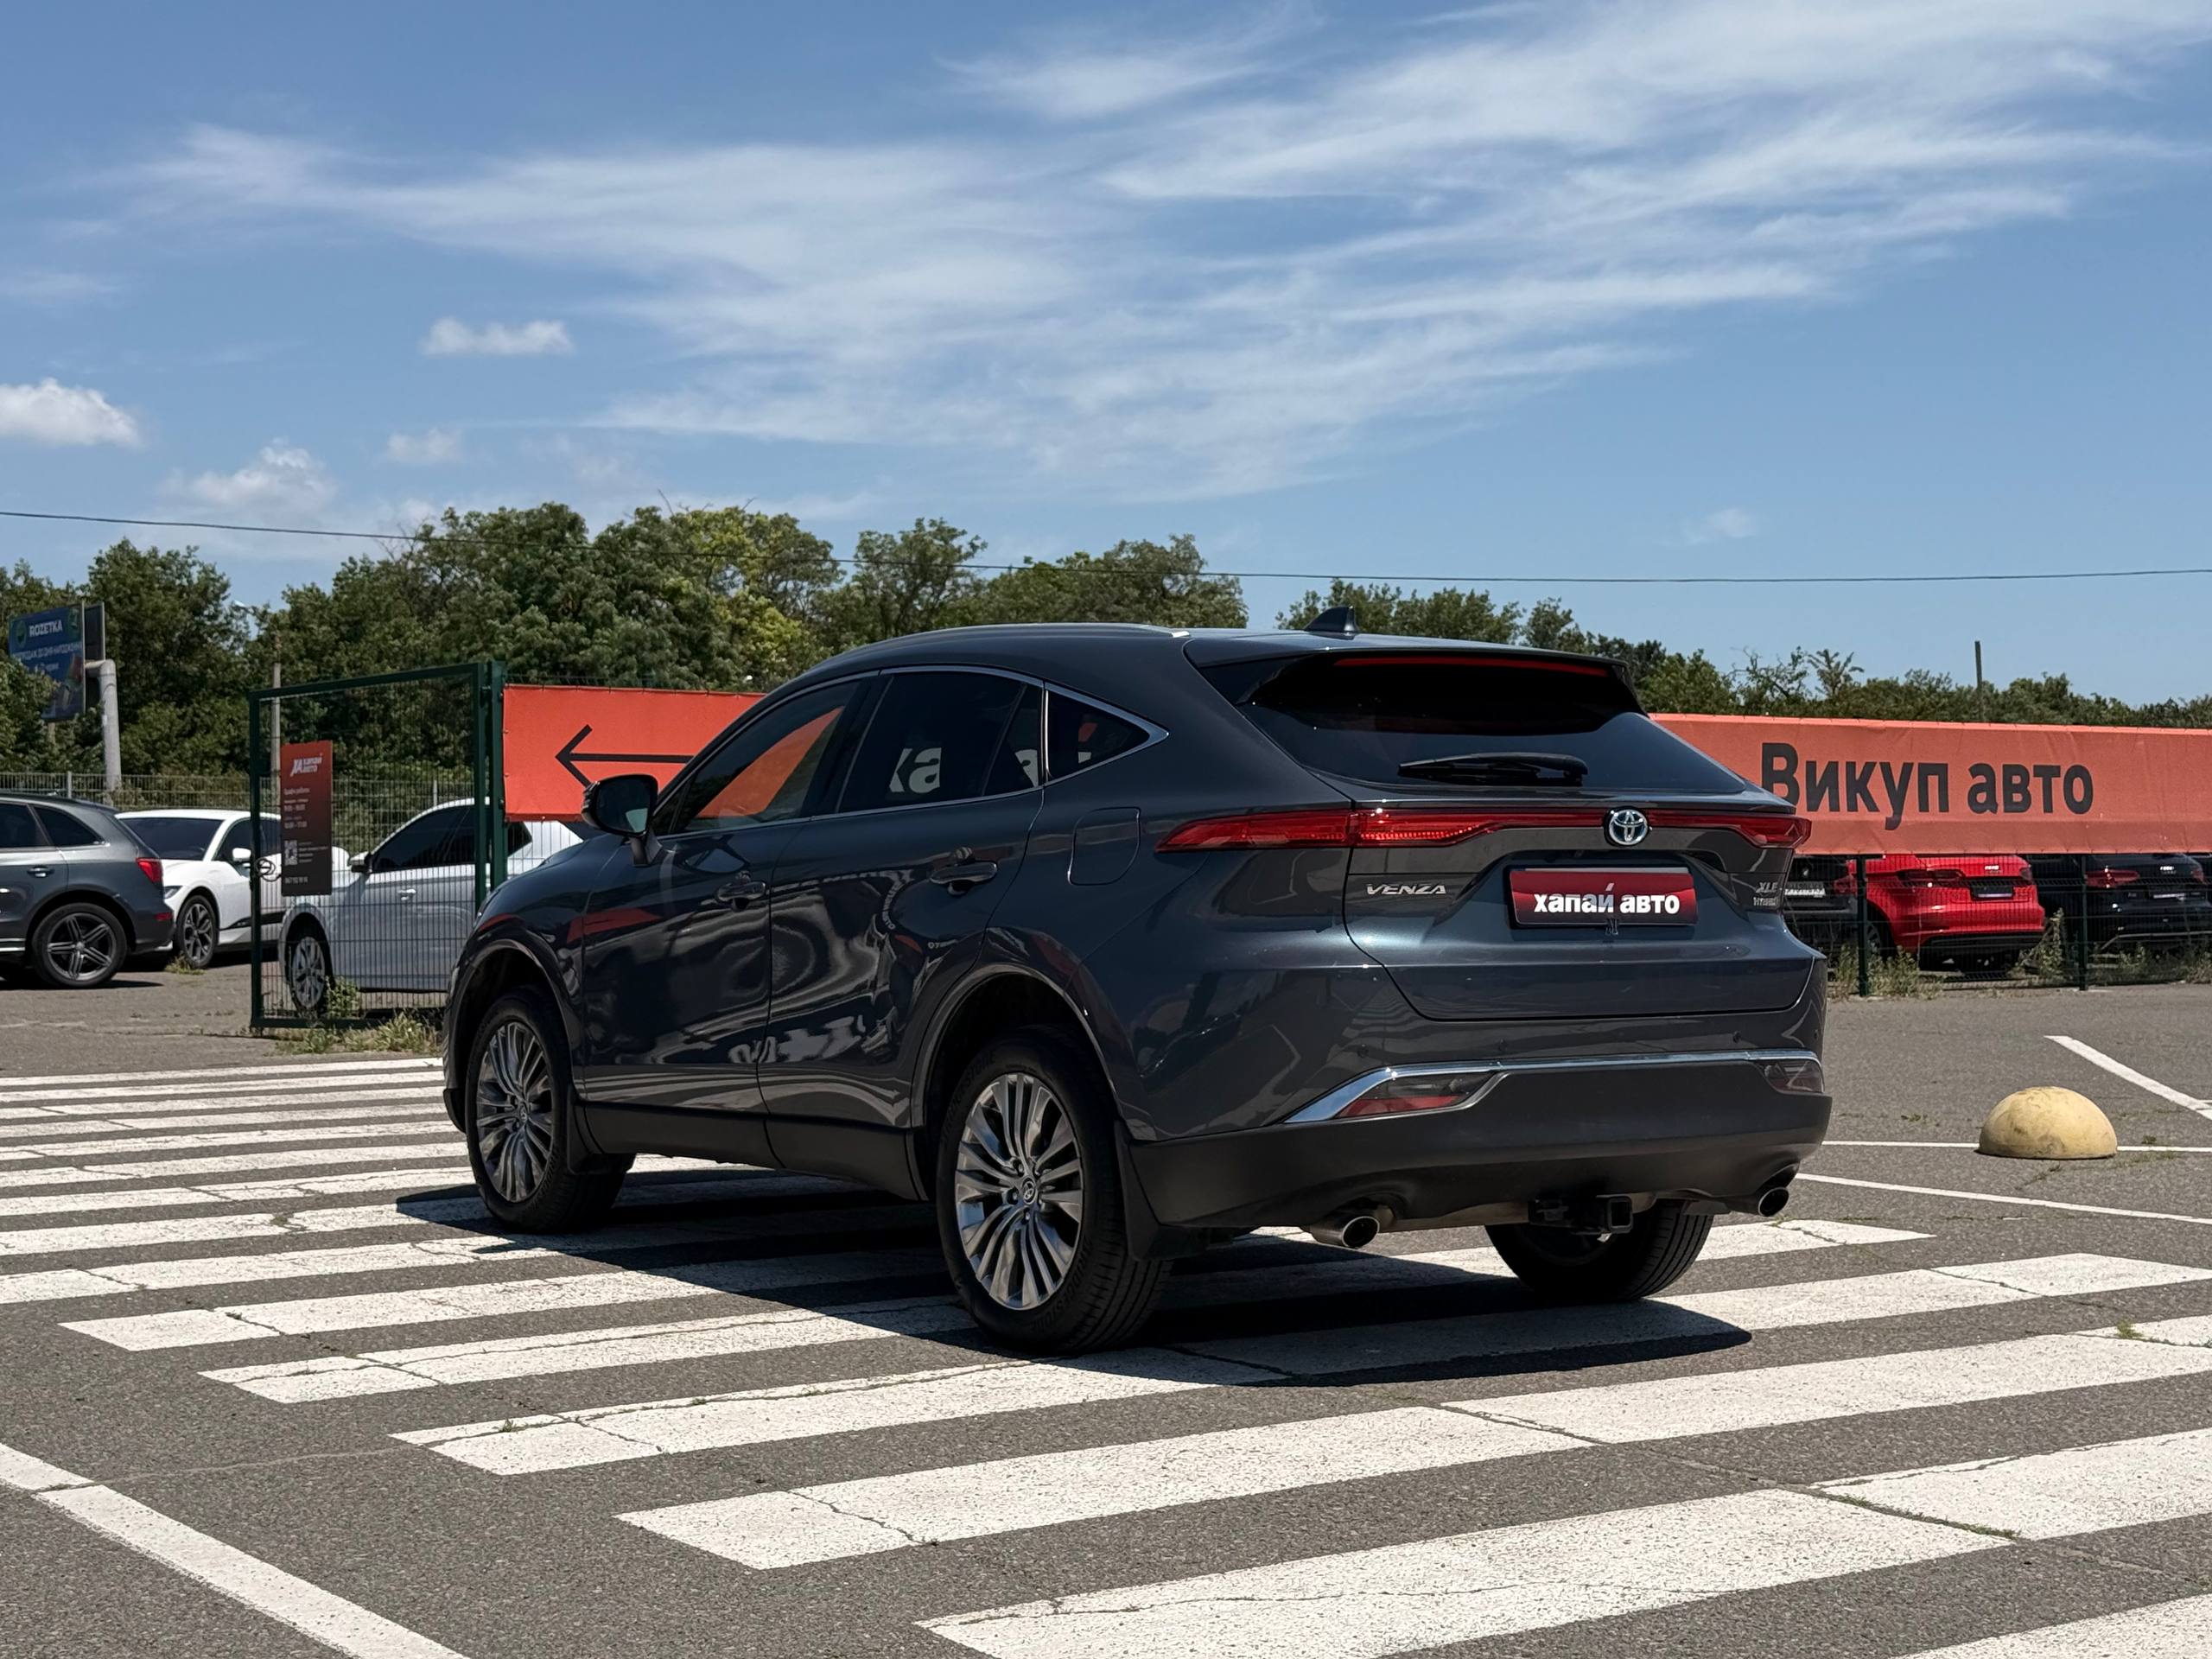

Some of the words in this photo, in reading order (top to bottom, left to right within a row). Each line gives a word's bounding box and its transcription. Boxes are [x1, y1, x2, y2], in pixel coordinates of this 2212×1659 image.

[29, 620, 63, 638] ROZETKA
[1761, 742, 1949, 830] Викуп
[1967, 762, 2094, 815] авто
[1367, 883, 1446, 895] VENZA
[1755, 881, 1778, 893] XLE
[1534, 882, 1614, 913] хапай
[1619, 894, 1681, 914] авто
